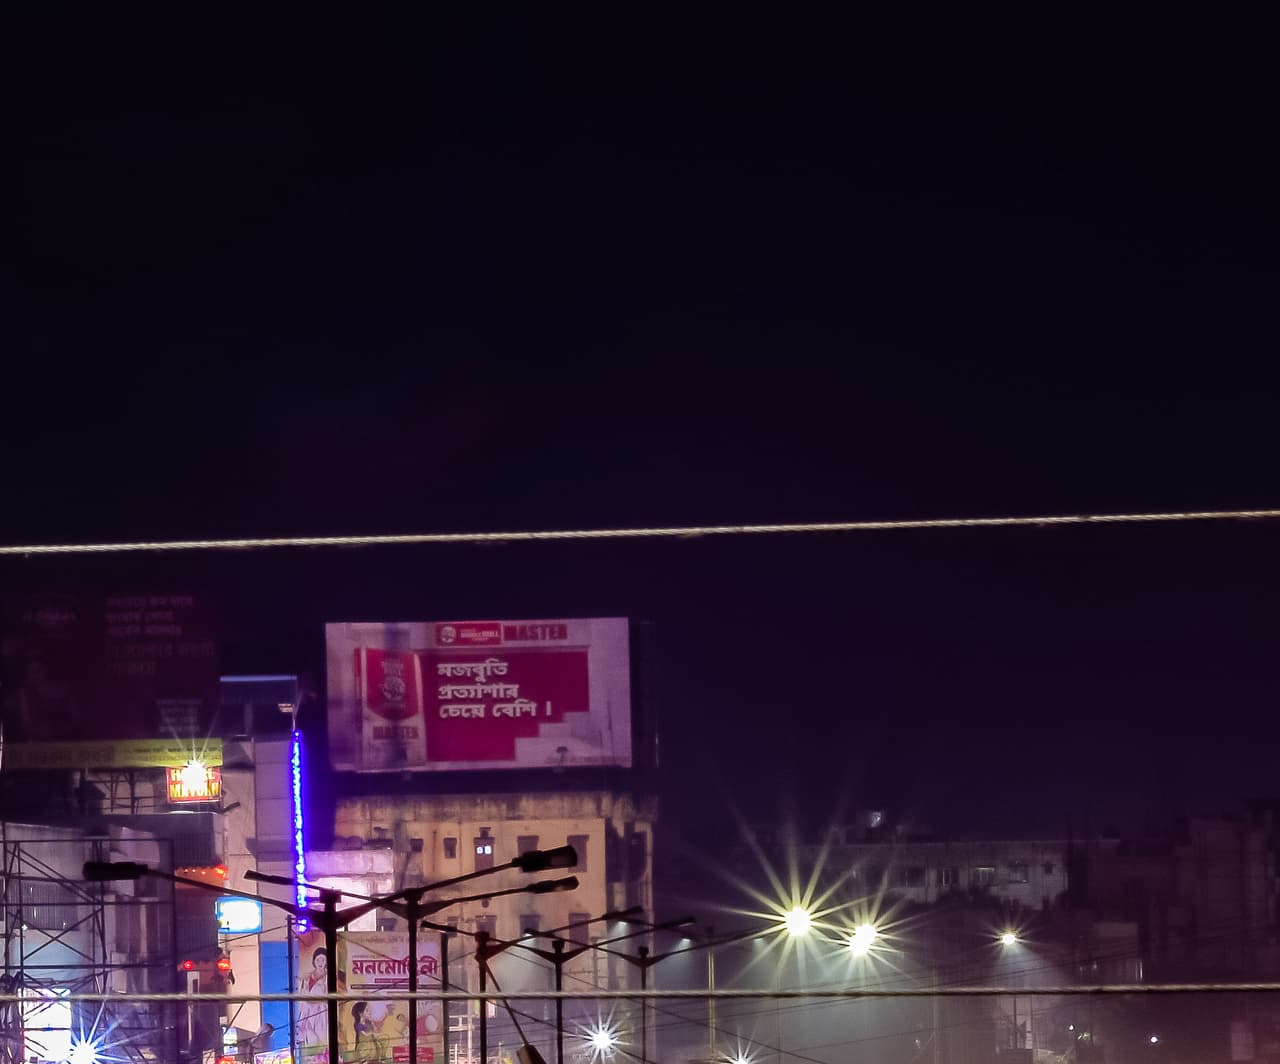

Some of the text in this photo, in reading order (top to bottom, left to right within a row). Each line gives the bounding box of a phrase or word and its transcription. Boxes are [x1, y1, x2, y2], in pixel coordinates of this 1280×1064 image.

[503, 624, 568, 641] MASTER
[437, 657, 509, 682] মজবুতি
[437, 683, 520, 701] প্রত্যাশার
[439, 700, 485, 719] চেয়ে
[492, 698, 537, 718] বেশি
[351, 955, 438, 976] মনমোিনী
